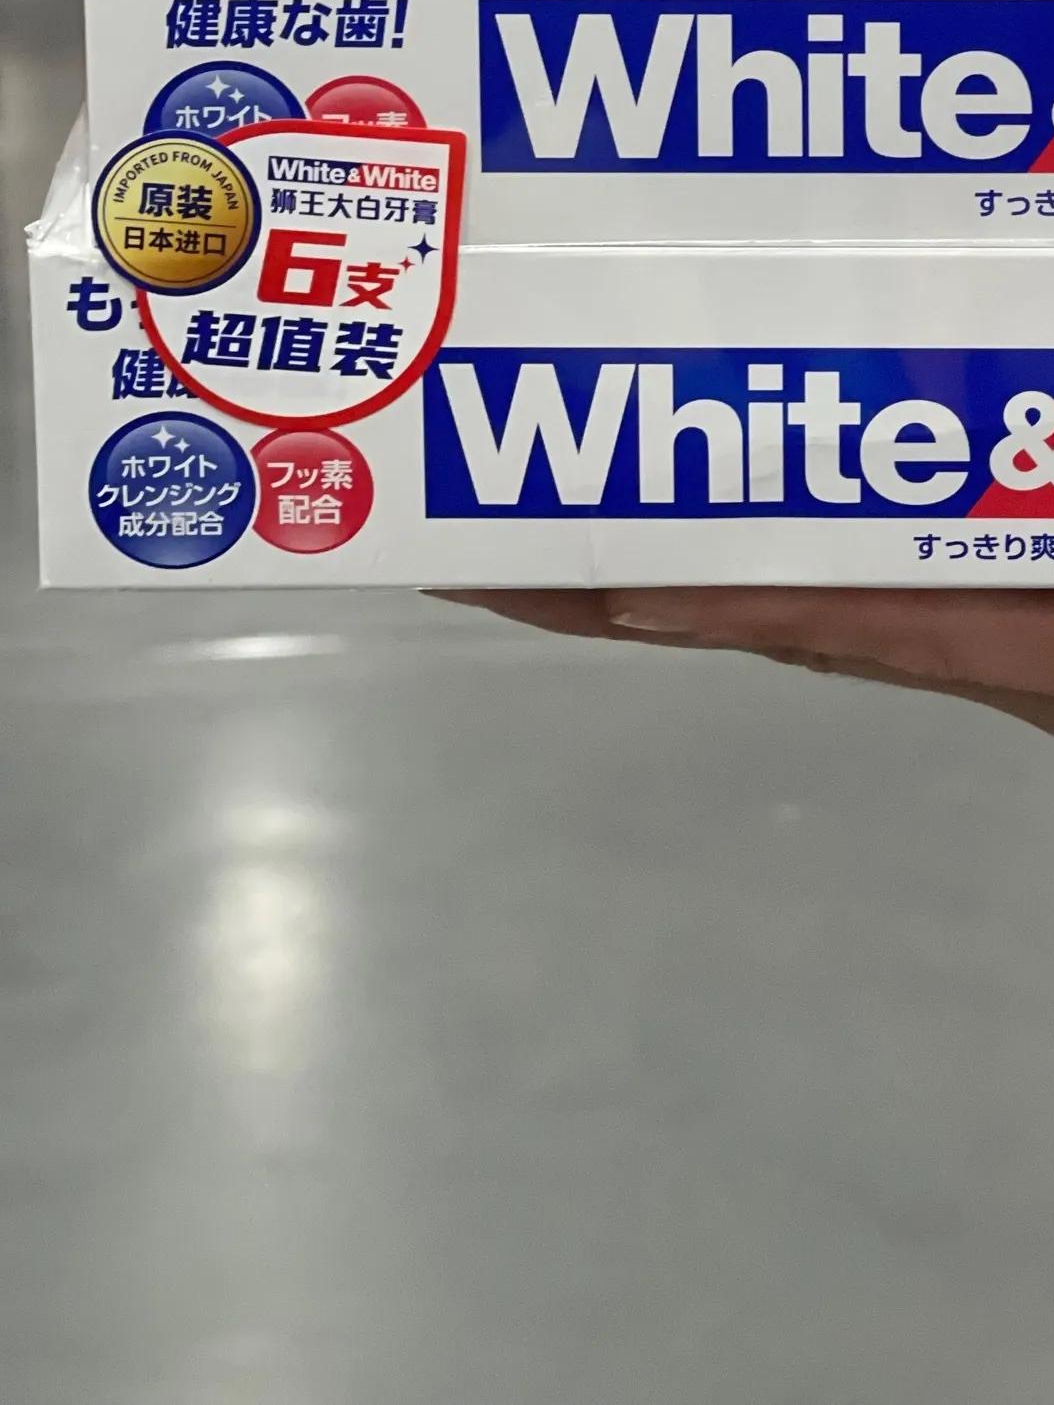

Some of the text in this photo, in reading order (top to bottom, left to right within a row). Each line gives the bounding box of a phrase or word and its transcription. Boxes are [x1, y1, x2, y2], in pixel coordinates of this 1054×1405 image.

[113, 150, 241, 210] IMPORTED FROM JAPAN
[138, 182, 214, 221] 原装
[270, 187, 438, 226] 狮王大白牙膏
[124, 226, 227, 257] 日本进口
[181, 309, 404, 380] 超值装
[121, 454, 218, 479] ホワイト
[266, 459, 354, 490] フッ素
[96, 481, 242, 508] クレンジング
[277, 494, 344, 526] 配合
[118, 510, 225, 537] 成分配合
